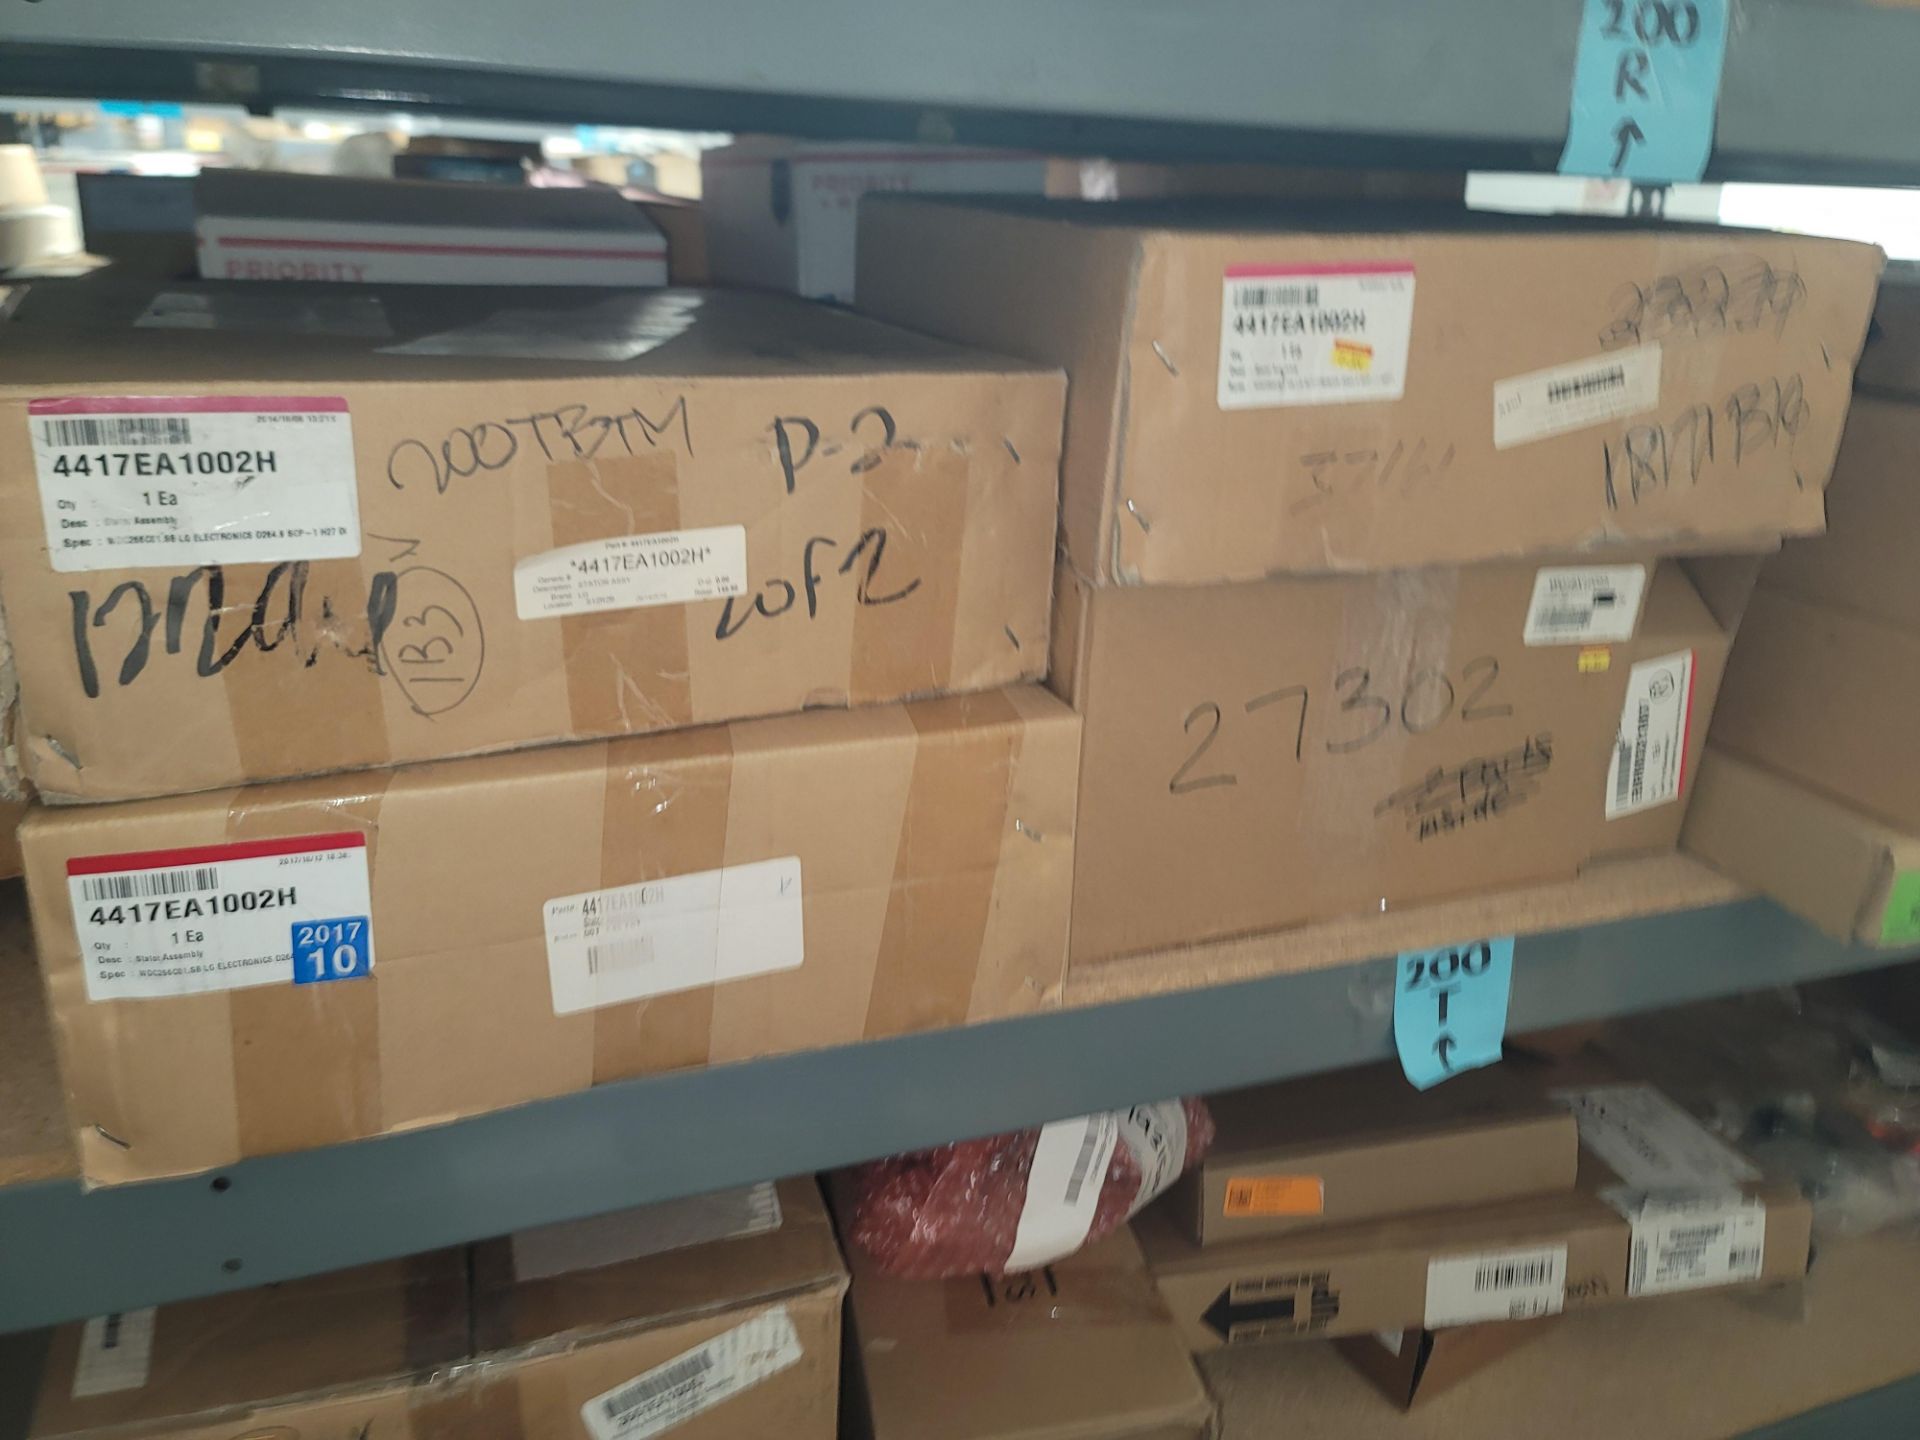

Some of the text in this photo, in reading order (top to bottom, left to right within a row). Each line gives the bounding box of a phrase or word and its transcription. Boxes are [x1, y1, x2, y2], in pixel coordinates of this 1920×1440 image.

[1600, 0, 1699, 45] 200
[1615, 51, 1650, 99] R
[226, 258, 368, 283] PRIORITY
[53, 450, 278, 478] 4417EA1002H
[142, 491, 151, 506] 1
[158, 490, 178, 506] Ea
[61, 518, 88, 528] Desc
[63, 538, 92, 550] Spec
[193, 531, 252, 544] ELECTRONICS
[1168, 655, 1513, 795] 27302
[90, 887, 297, 925] 4417EA1002H
[94, 928, 205, 951] Qty 1 Ea
[298, 921, 362, 946] 2017
[98, 955, 123, 965] Desc
[162, 950, 204, 961] Assembly
[99, 969, 127, 980] Spec
[217, 955, 273, 970] ELECTRONICS
[307, 944, 358, 978] 10
